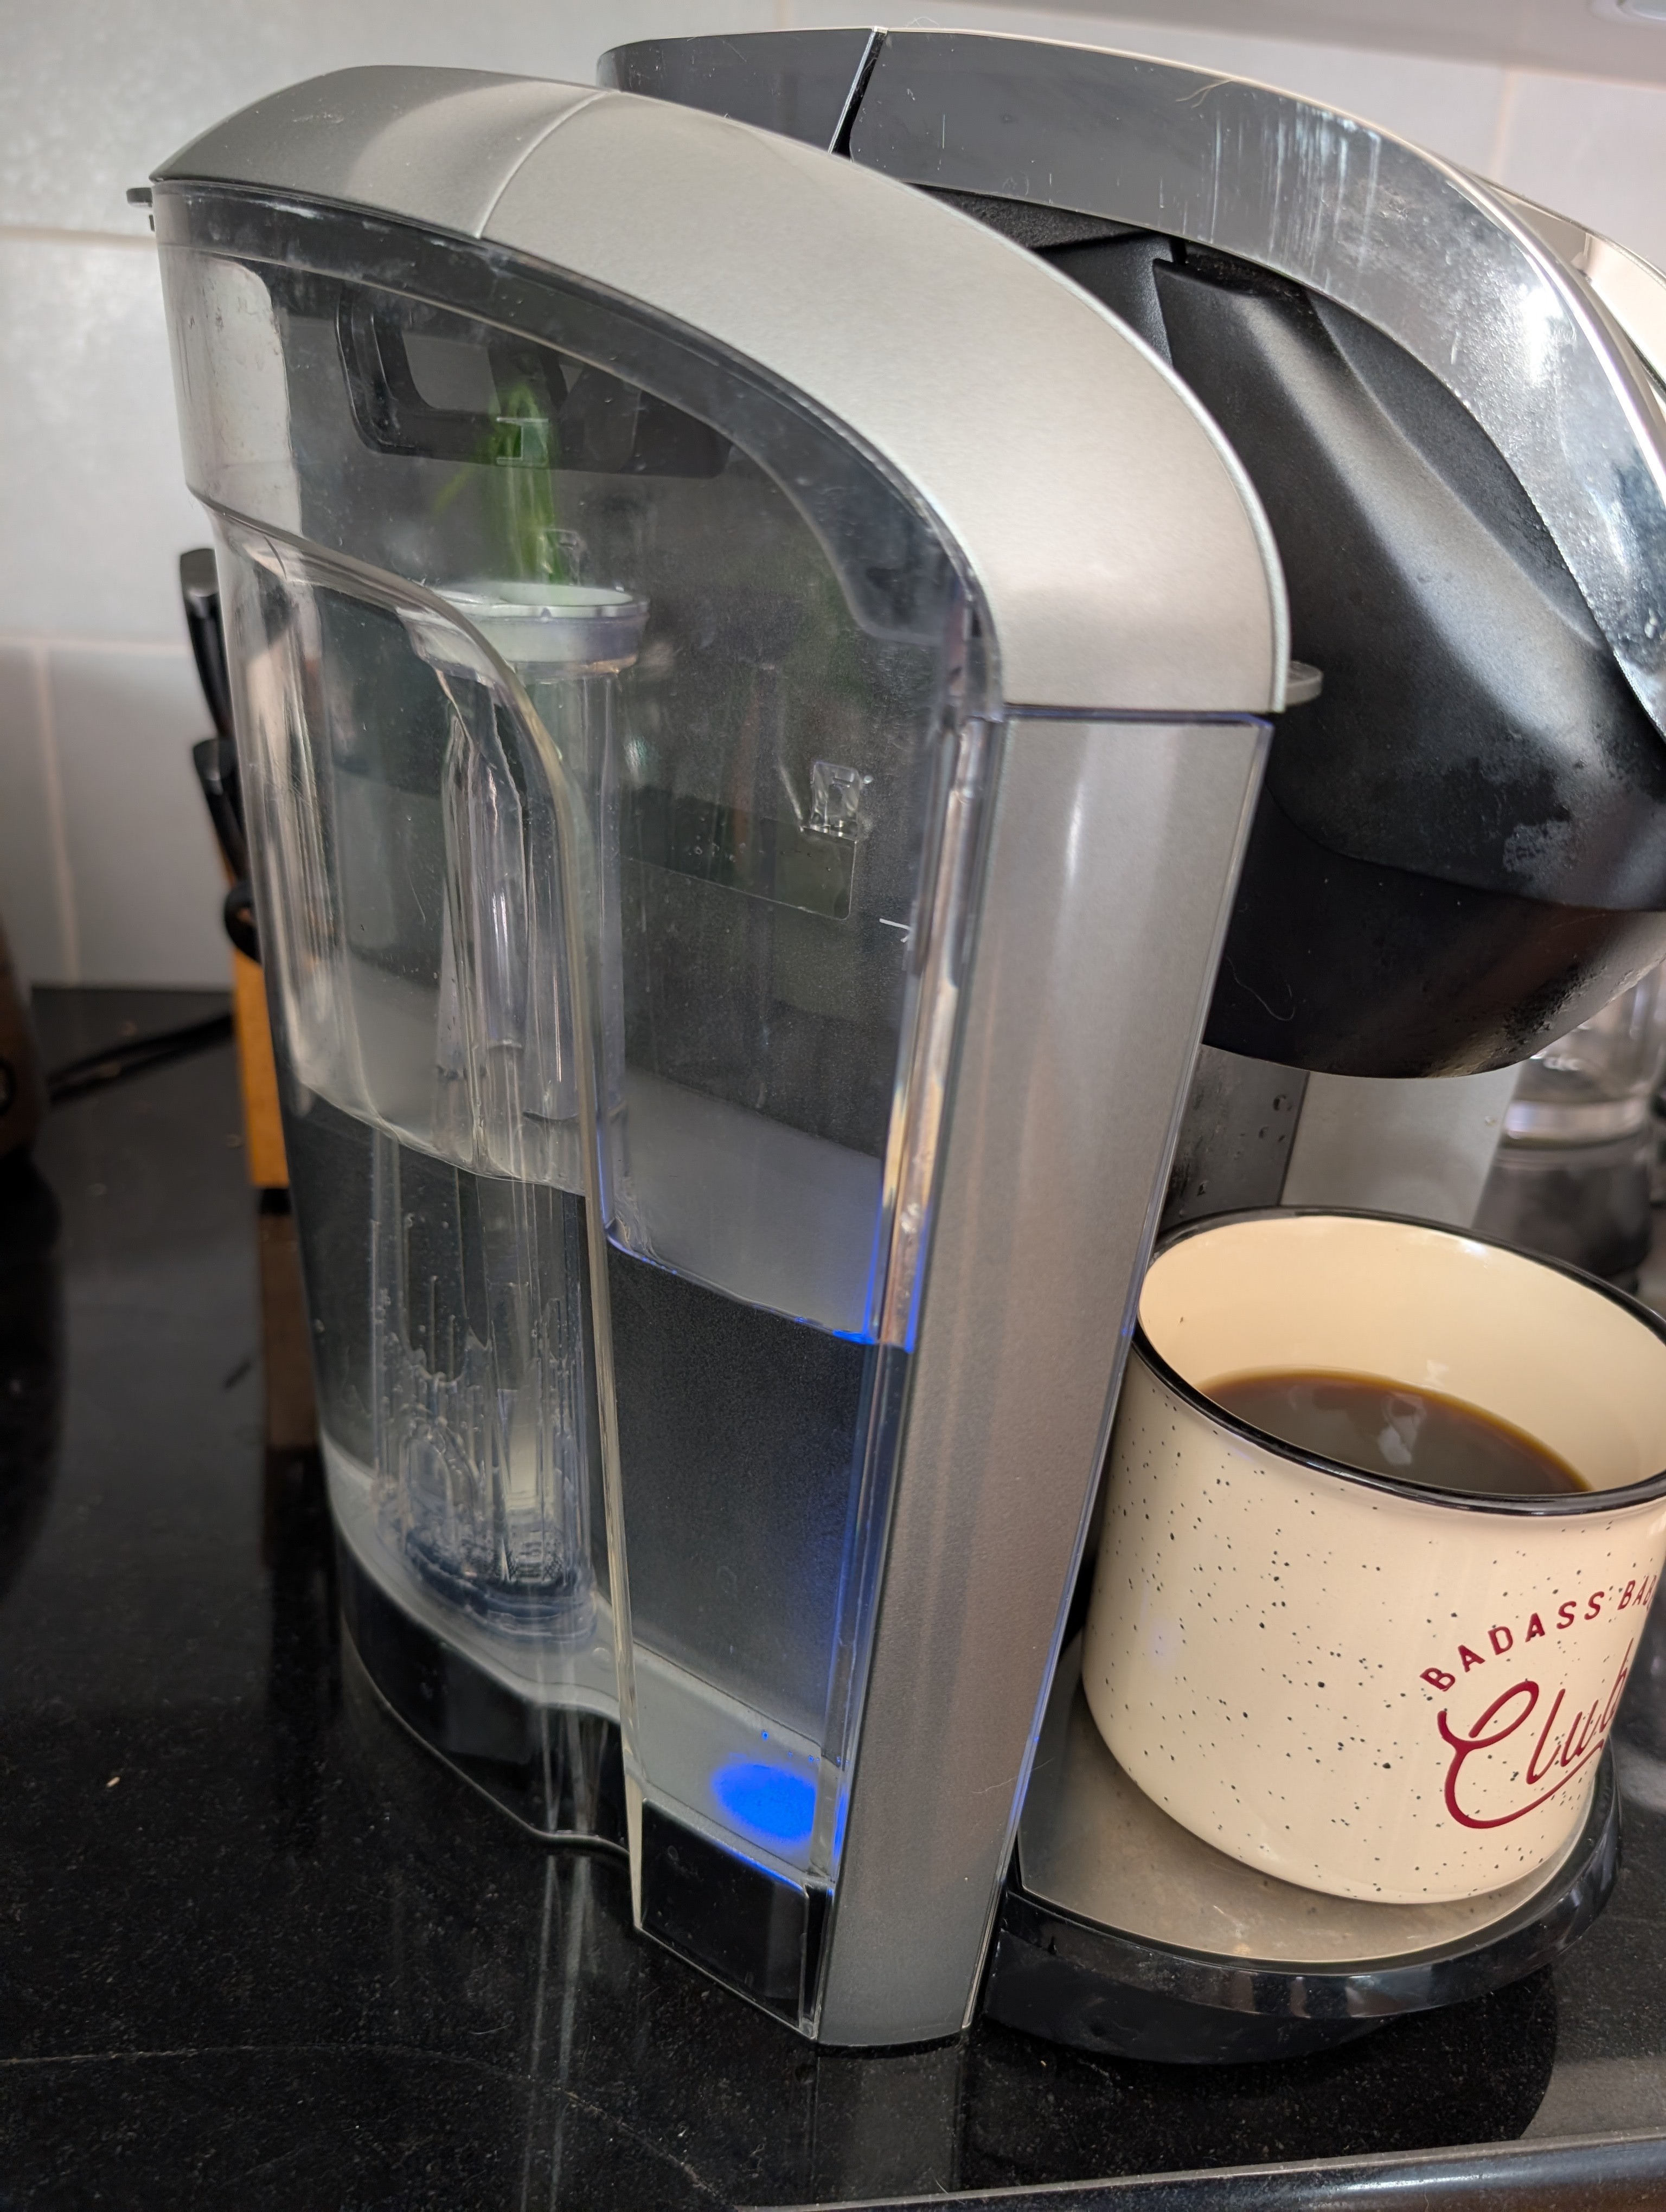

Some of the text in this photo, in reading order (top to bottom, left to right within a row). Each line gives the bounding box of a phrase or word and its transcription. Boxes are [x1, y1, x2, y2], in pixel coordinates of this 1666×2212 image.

[1419, 1574, 1657, 1692] BADASS BAB
[1437, 1637, 1634, 1829] Club
